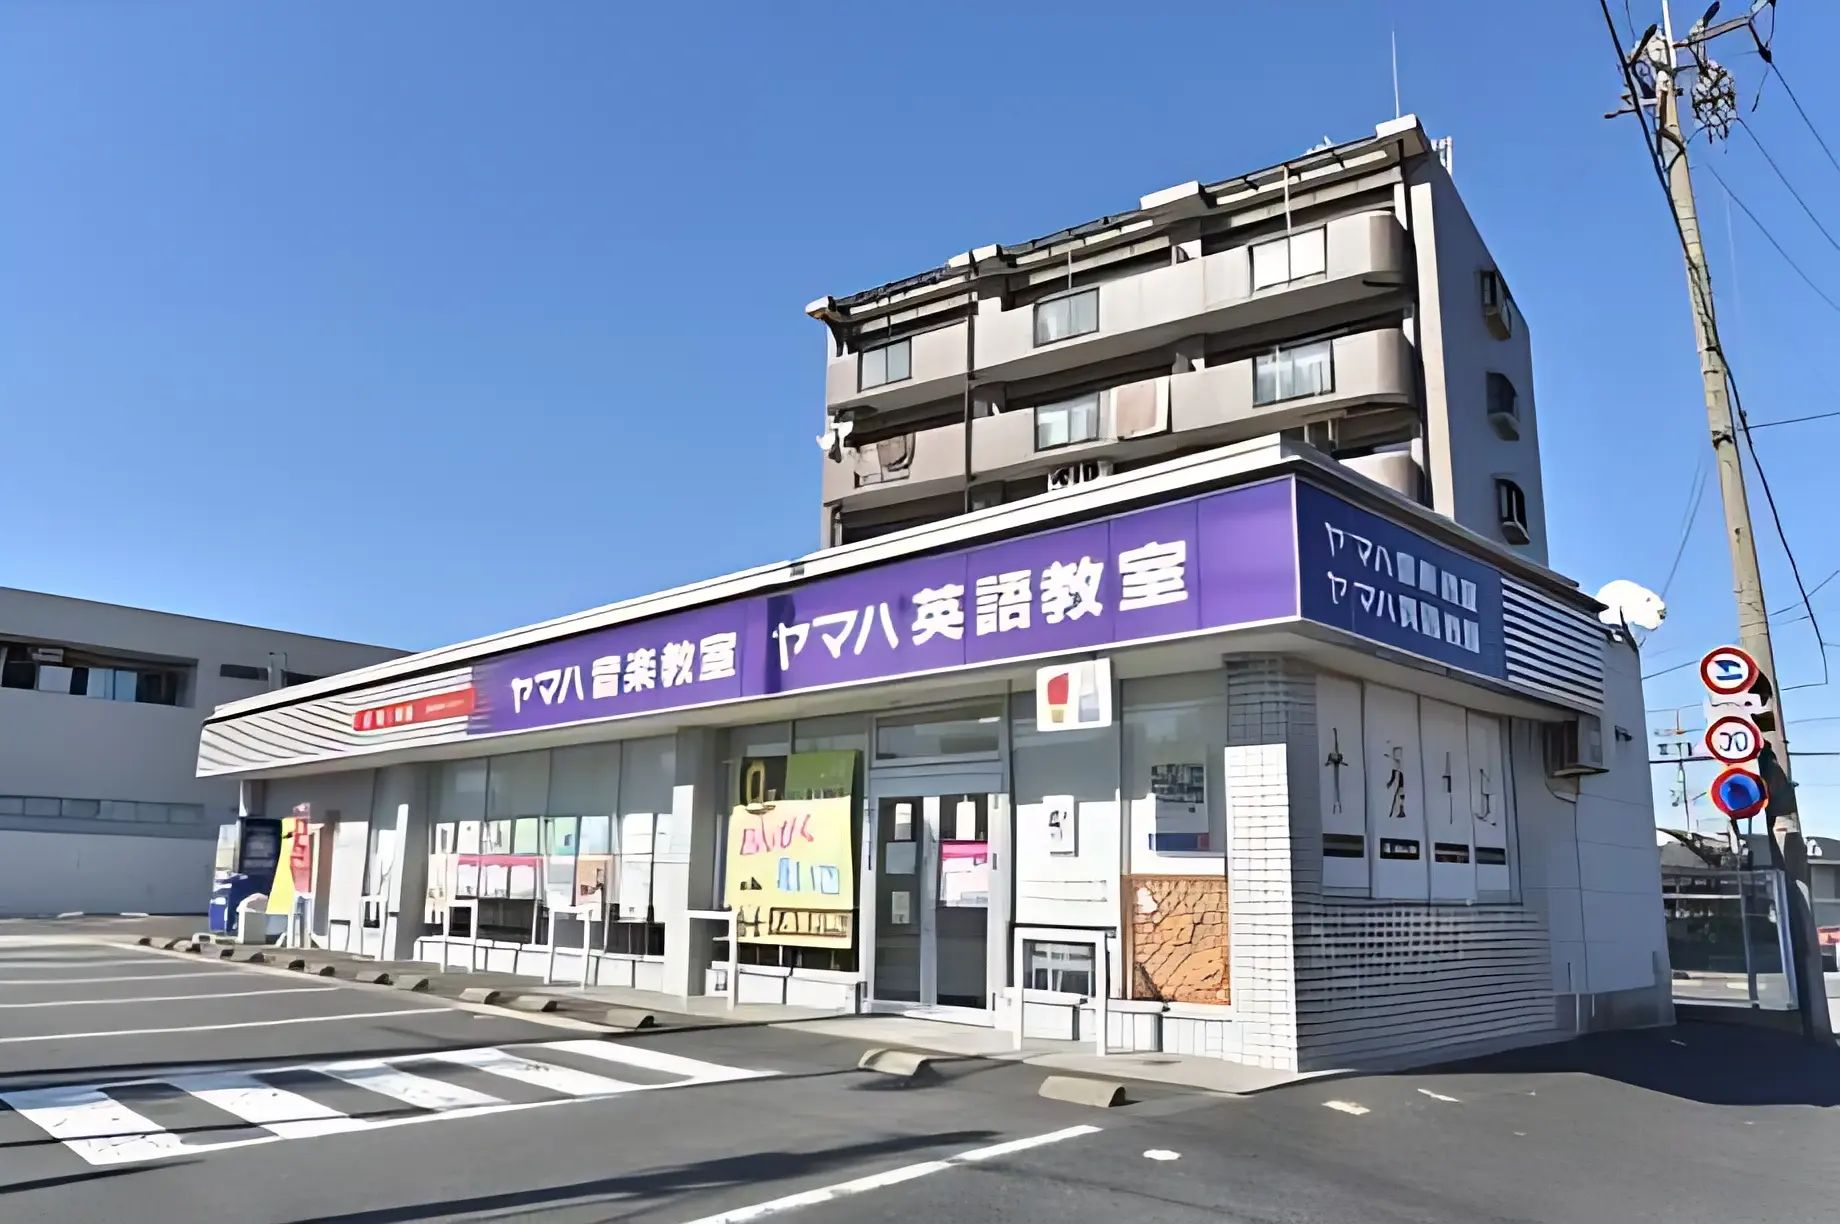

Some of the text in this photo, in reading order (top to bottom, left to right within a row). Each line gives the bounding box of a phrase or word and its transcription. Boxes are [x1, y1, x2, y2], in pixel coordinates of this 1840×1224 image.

[772, 540, 1189, 671] ヤマハ英語教室
